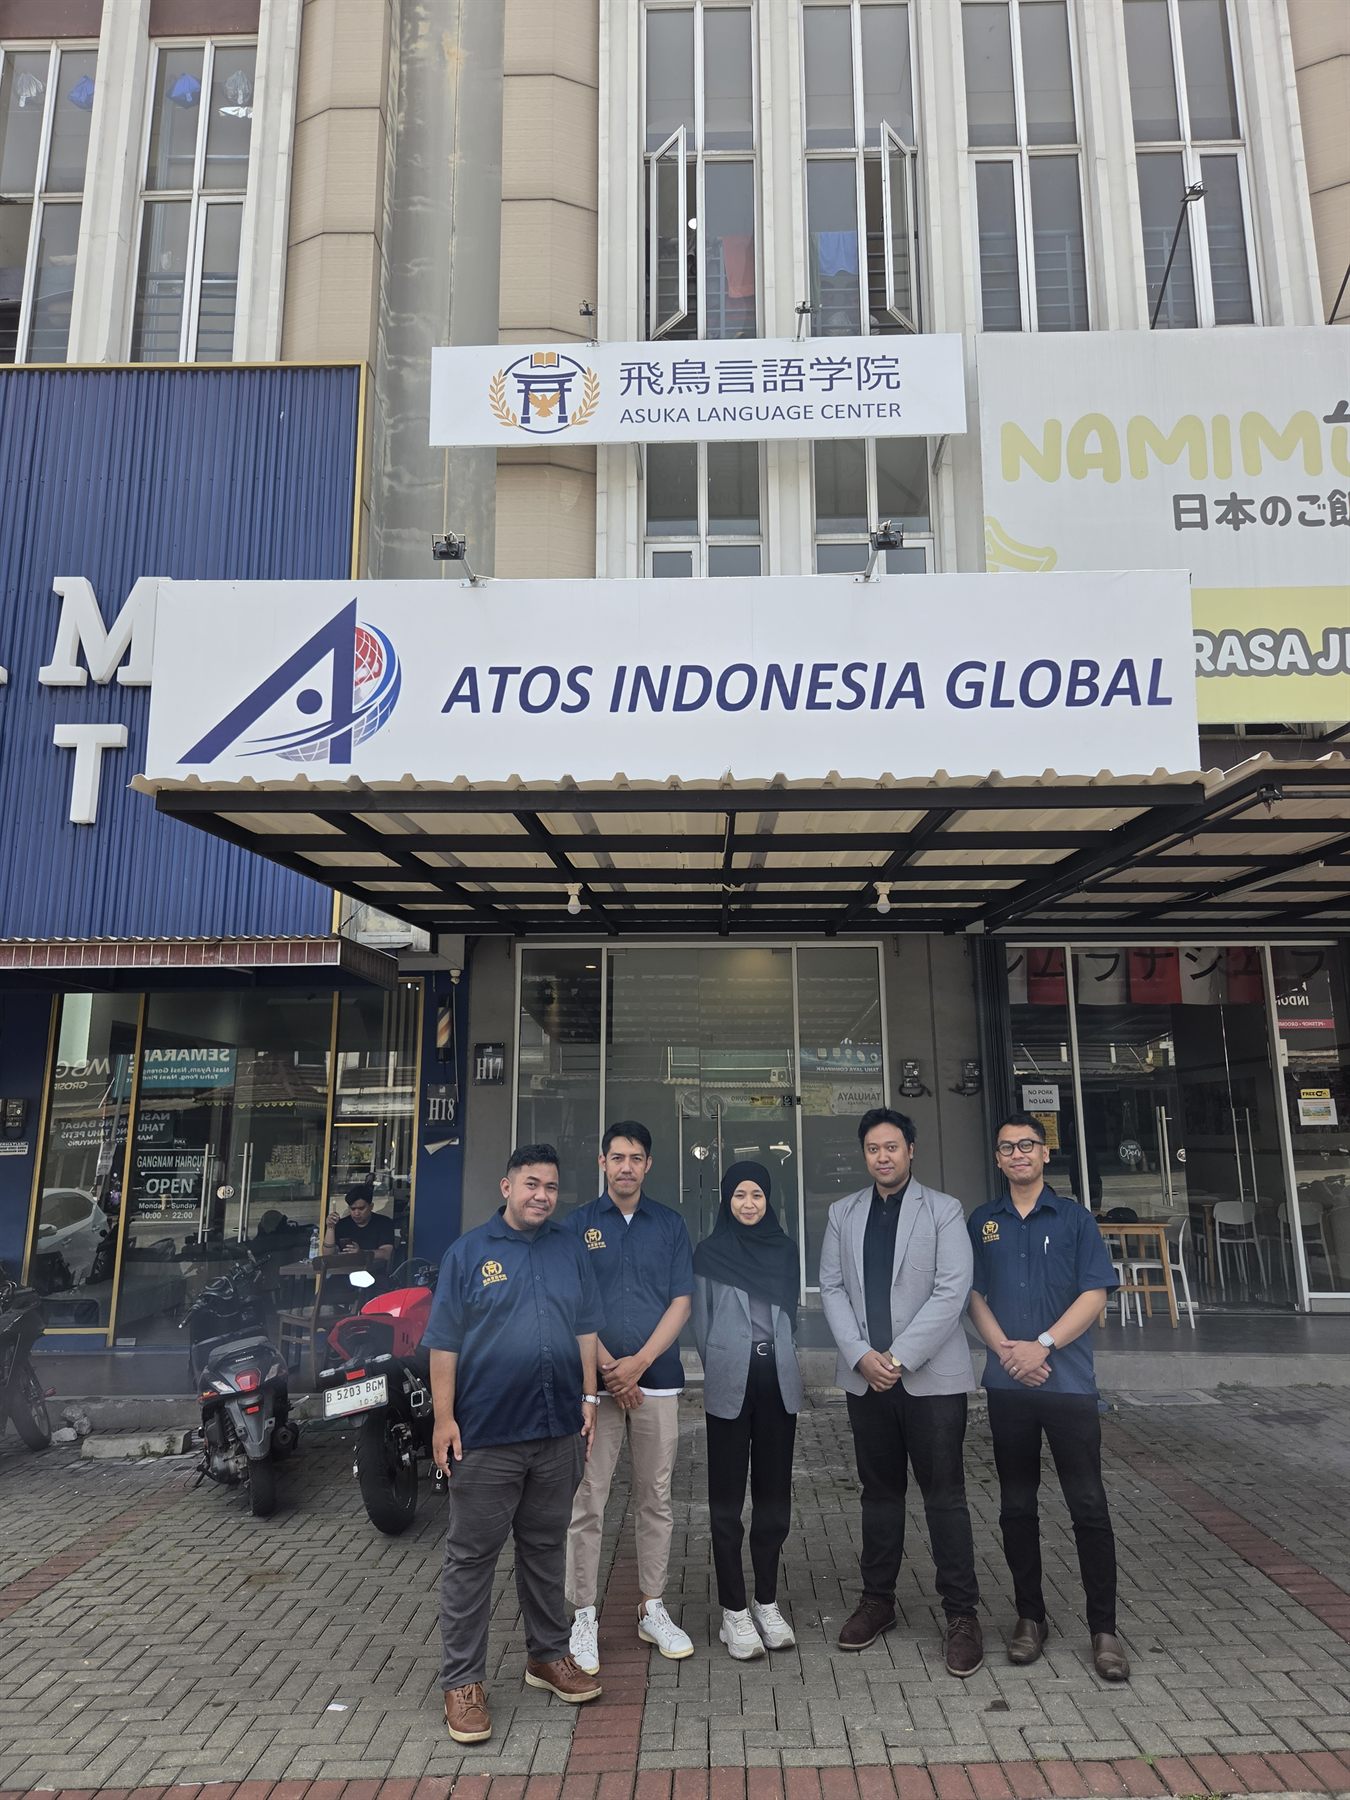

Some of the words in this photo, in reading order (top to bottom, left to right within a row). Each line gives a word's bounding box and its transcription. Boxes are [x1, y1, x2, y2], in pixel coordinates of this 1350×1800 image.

[620, 354, 901, 396] 飛鳥言語学院
[620, 408, 690, 424] ASUKA
[697, 405, 814, 423] LANGUAGE
[821, 403, 902, 420] CENTER
[441, 665, 593, 714] ATOS
[609, 662, 925, 713] INDONESIA
[946, 658, 1173, 710] GLOBAL
[477, 1057, 501, 1080] H17
[428, 1098, 455, 1121] H18
[137, 1155, 173, 1168] GANGNAM
[146, 1178, 194, 1194] OPEN
[138, 1202, 166, 1211] Monday
[171, 1202, 197, 1211] Sunday
[142, 1211, 162, 1219] 10:00
[172, 1211, 193, 1219] 22:00
[326, 1392, 333, 1404] B
[336, 1385, 362, 1401] 5203
